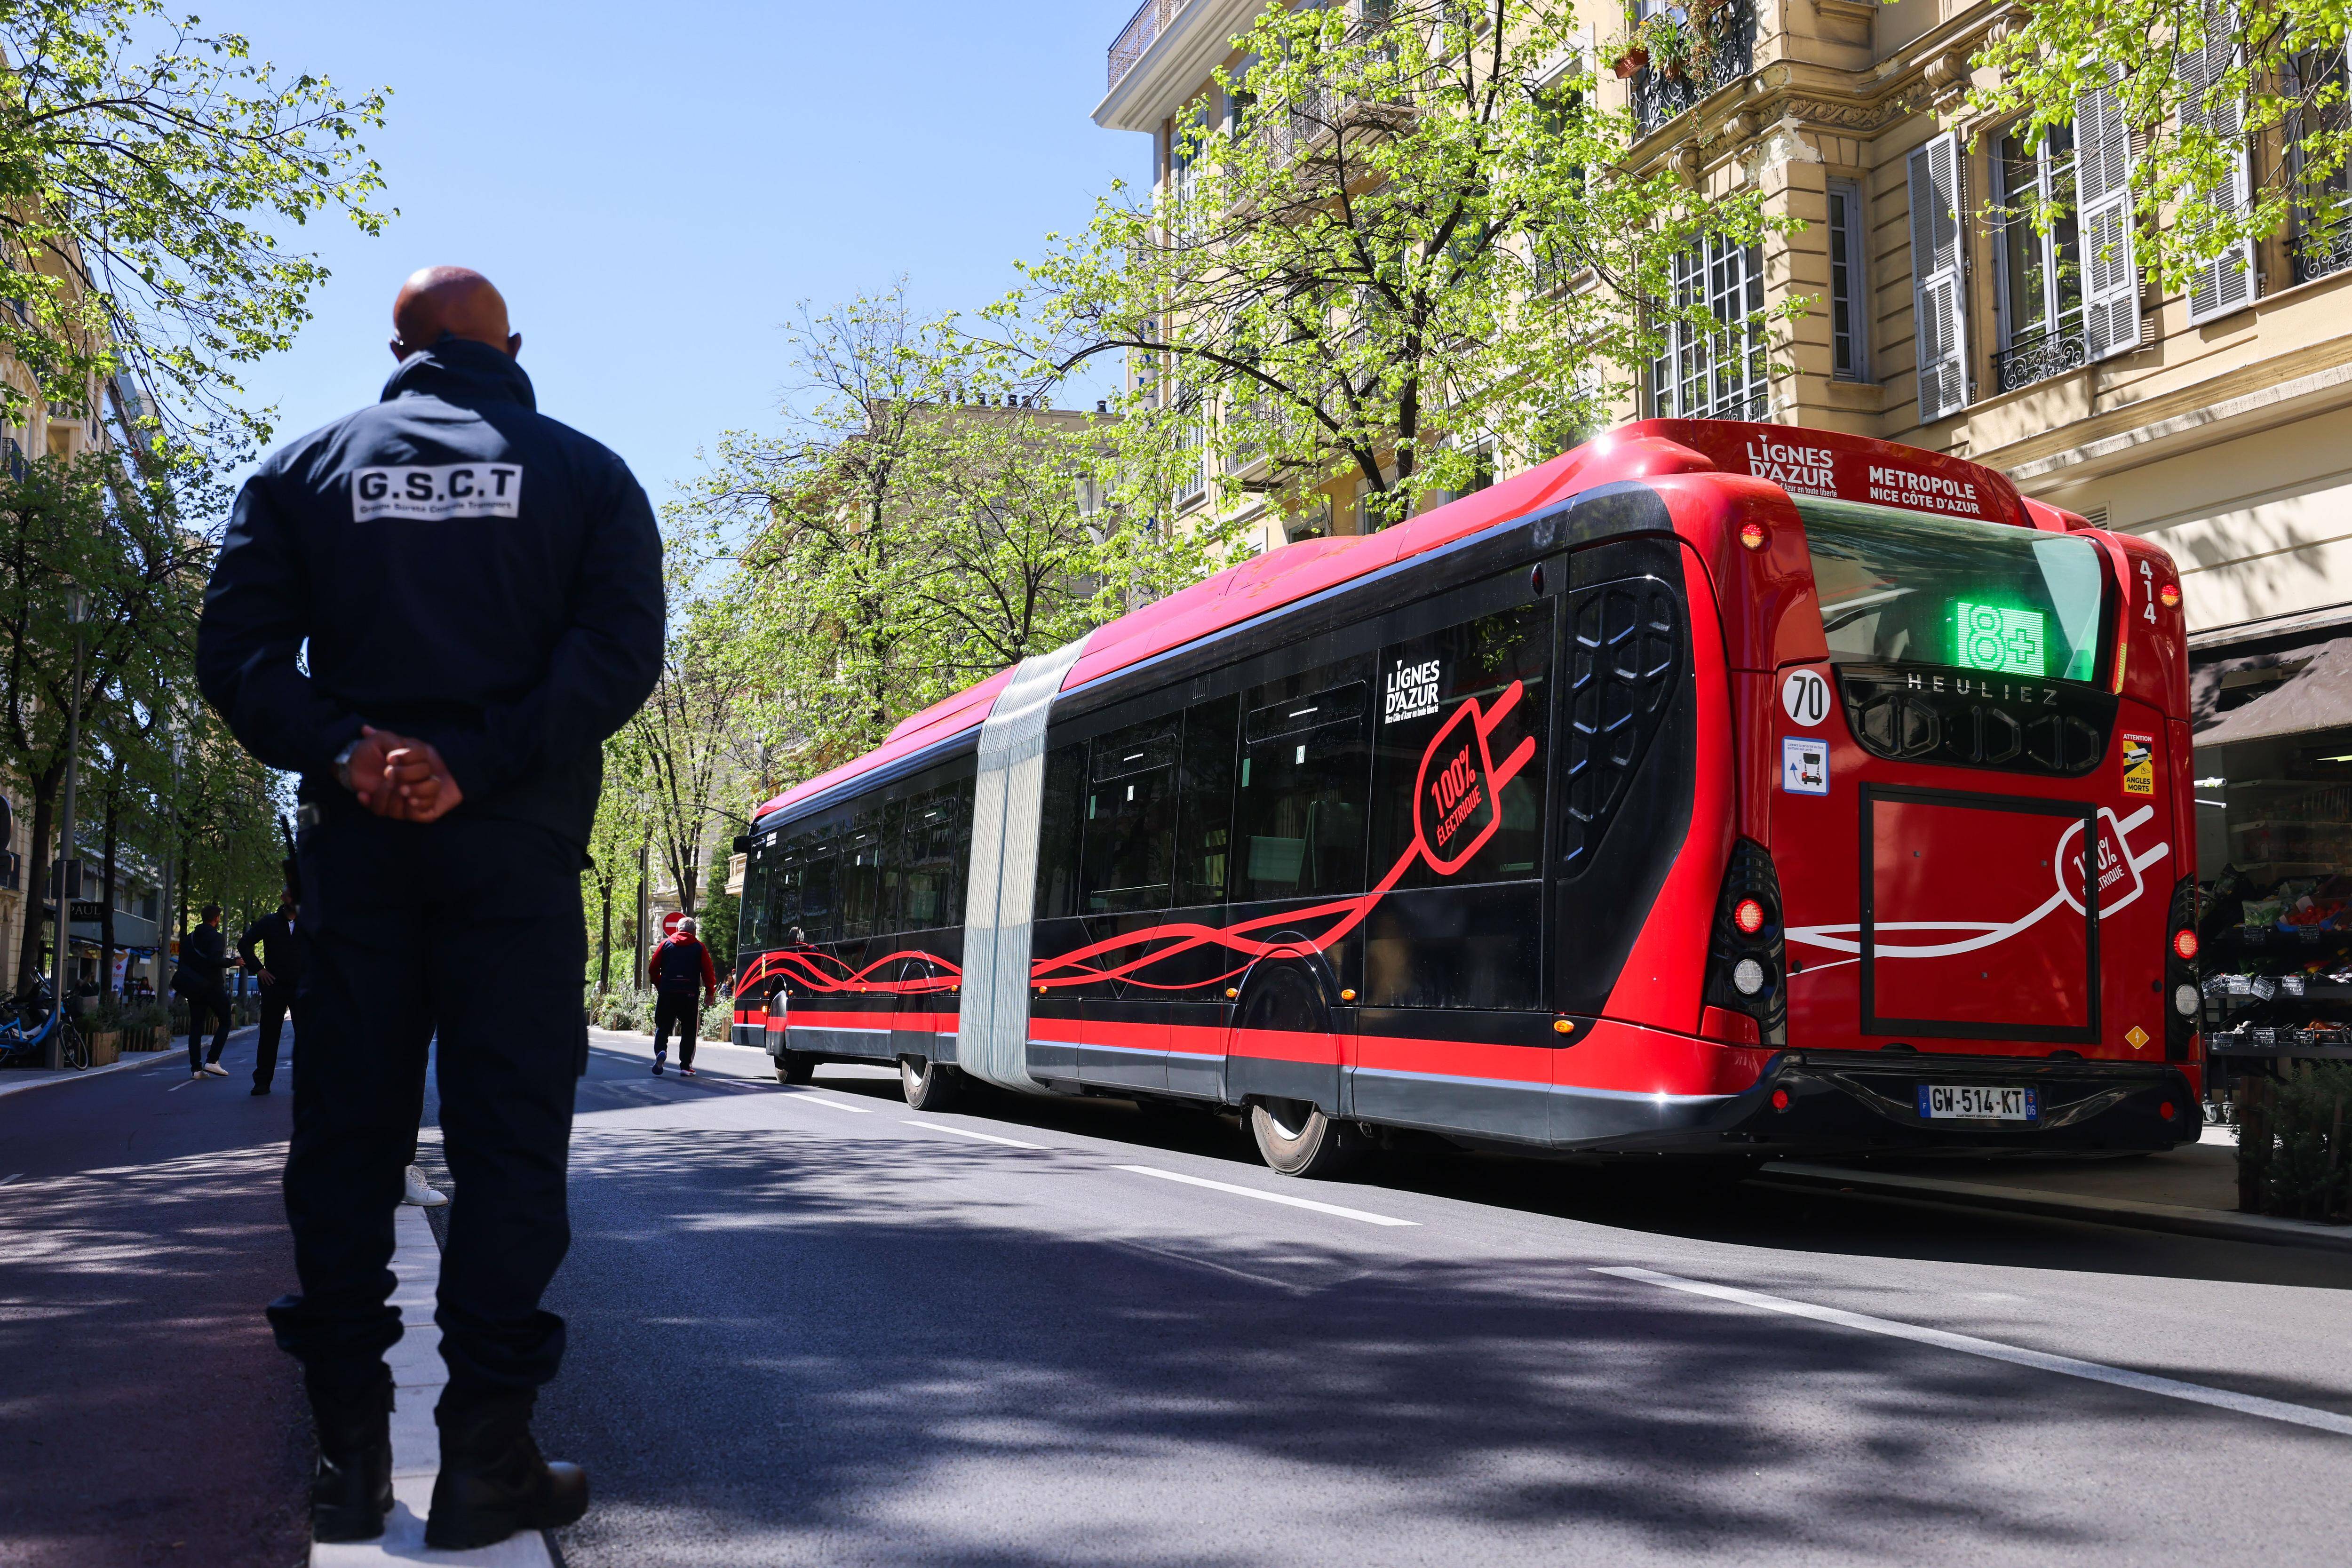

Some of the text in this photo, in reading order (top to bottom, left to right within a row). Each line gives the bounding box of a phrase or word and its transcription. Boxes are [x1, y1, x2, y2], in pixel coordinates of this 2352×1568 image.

[1747, 434, 1834, 468] LIGNES
[359, 469, 516, 501] G.S.C.T
[1749, 461, 1836, 489] D'AZUR
[1869, 466, 1977, 500] METROPOLE
[1805, 486, 1819, 495] toute
[1820, 487, 1837, 497] liberté
[1870, 486, 1980, 514] NICE CÔTE D'AZUR
[1387, 660, 1440, 693] LIGNES
[1907, 673, 2057, 706] HEULIEZ
[1386, 683, 1439, 714] D'AZUR
[1792, 676, 1822, 720] 70
[1431, 744, 1476, 819] 100%
[1437, 785, 1482, 847] ÉLECTRIQUE
[1932, 1088, 2022, 1114] GW-514-KT
[2026, 1105, 2036, 1115] 06
